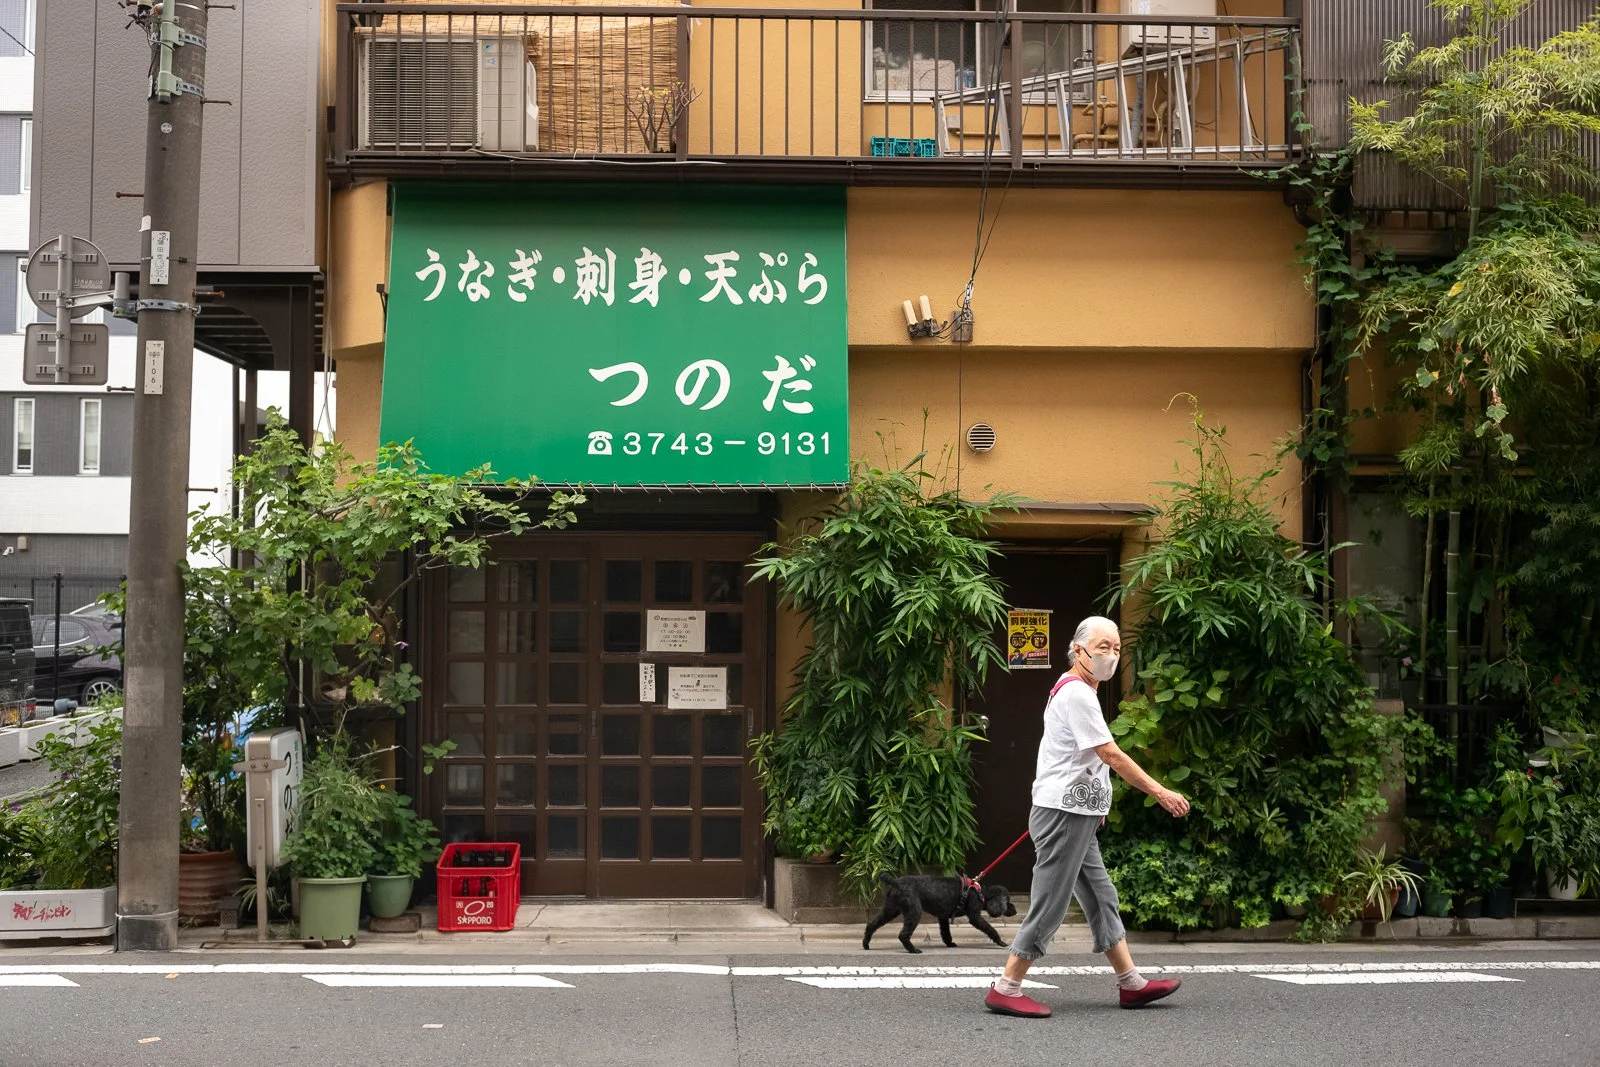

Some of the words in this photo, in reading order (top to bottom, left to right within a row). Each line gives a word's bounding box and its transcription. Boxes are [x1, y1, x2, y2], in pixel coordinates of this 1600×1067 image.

[154, 270, 165, 278] 32
[415, 246, 828, 308] うなぎ・刺身・天ぷら
[588, 354, 817, 414] つのだ
[1010, 616, 1047, 626] 罰則強化
